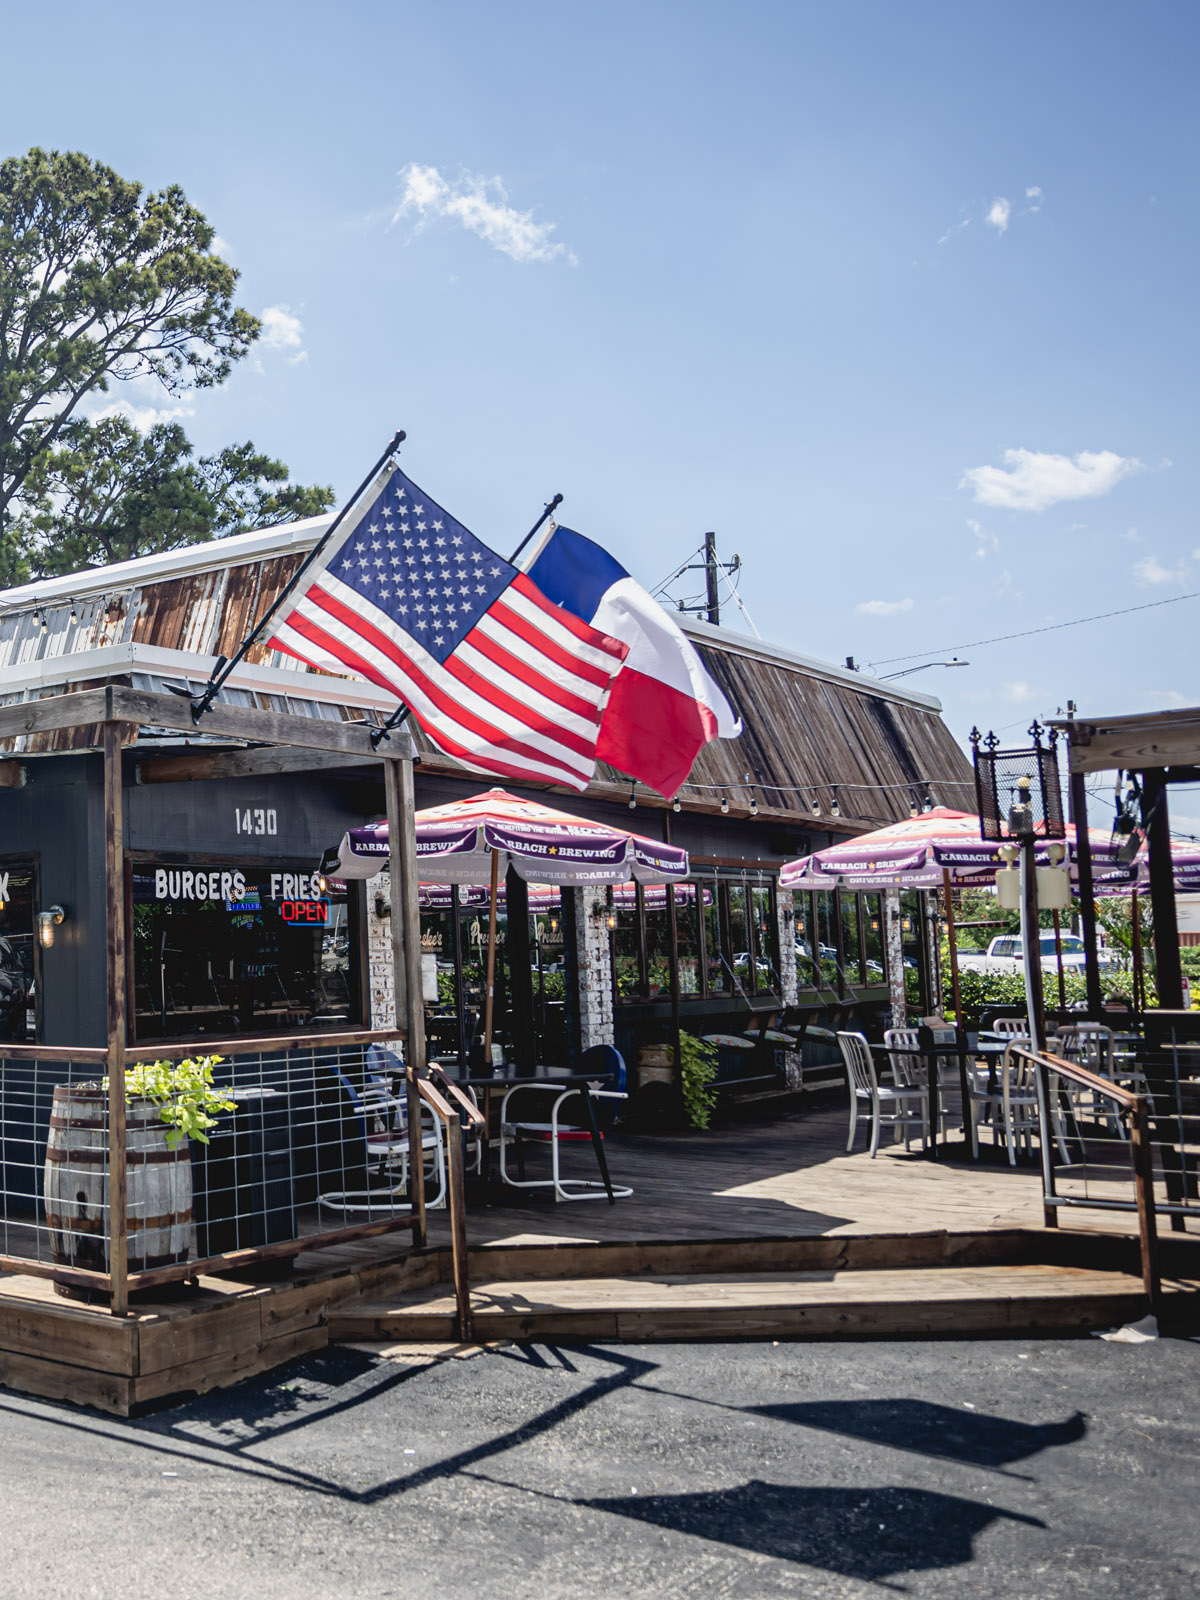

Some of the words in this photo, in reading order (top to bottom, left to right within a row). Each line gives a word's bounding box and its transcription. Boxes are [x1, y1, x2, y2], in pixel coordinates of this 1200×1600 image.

[235, 808, 277, 835] 1430
[355, 843, 390, 851] KARBA
[558, 847, 617, 859] BREWING
[875, 856, 919, 869] BREWING
[940, 853, 990, 862] KARBACH
[155, 869, 246, 901] BURGERS
[270, 873, 321, 901] FRIES
[281, 901, 328, 921] OPEN
